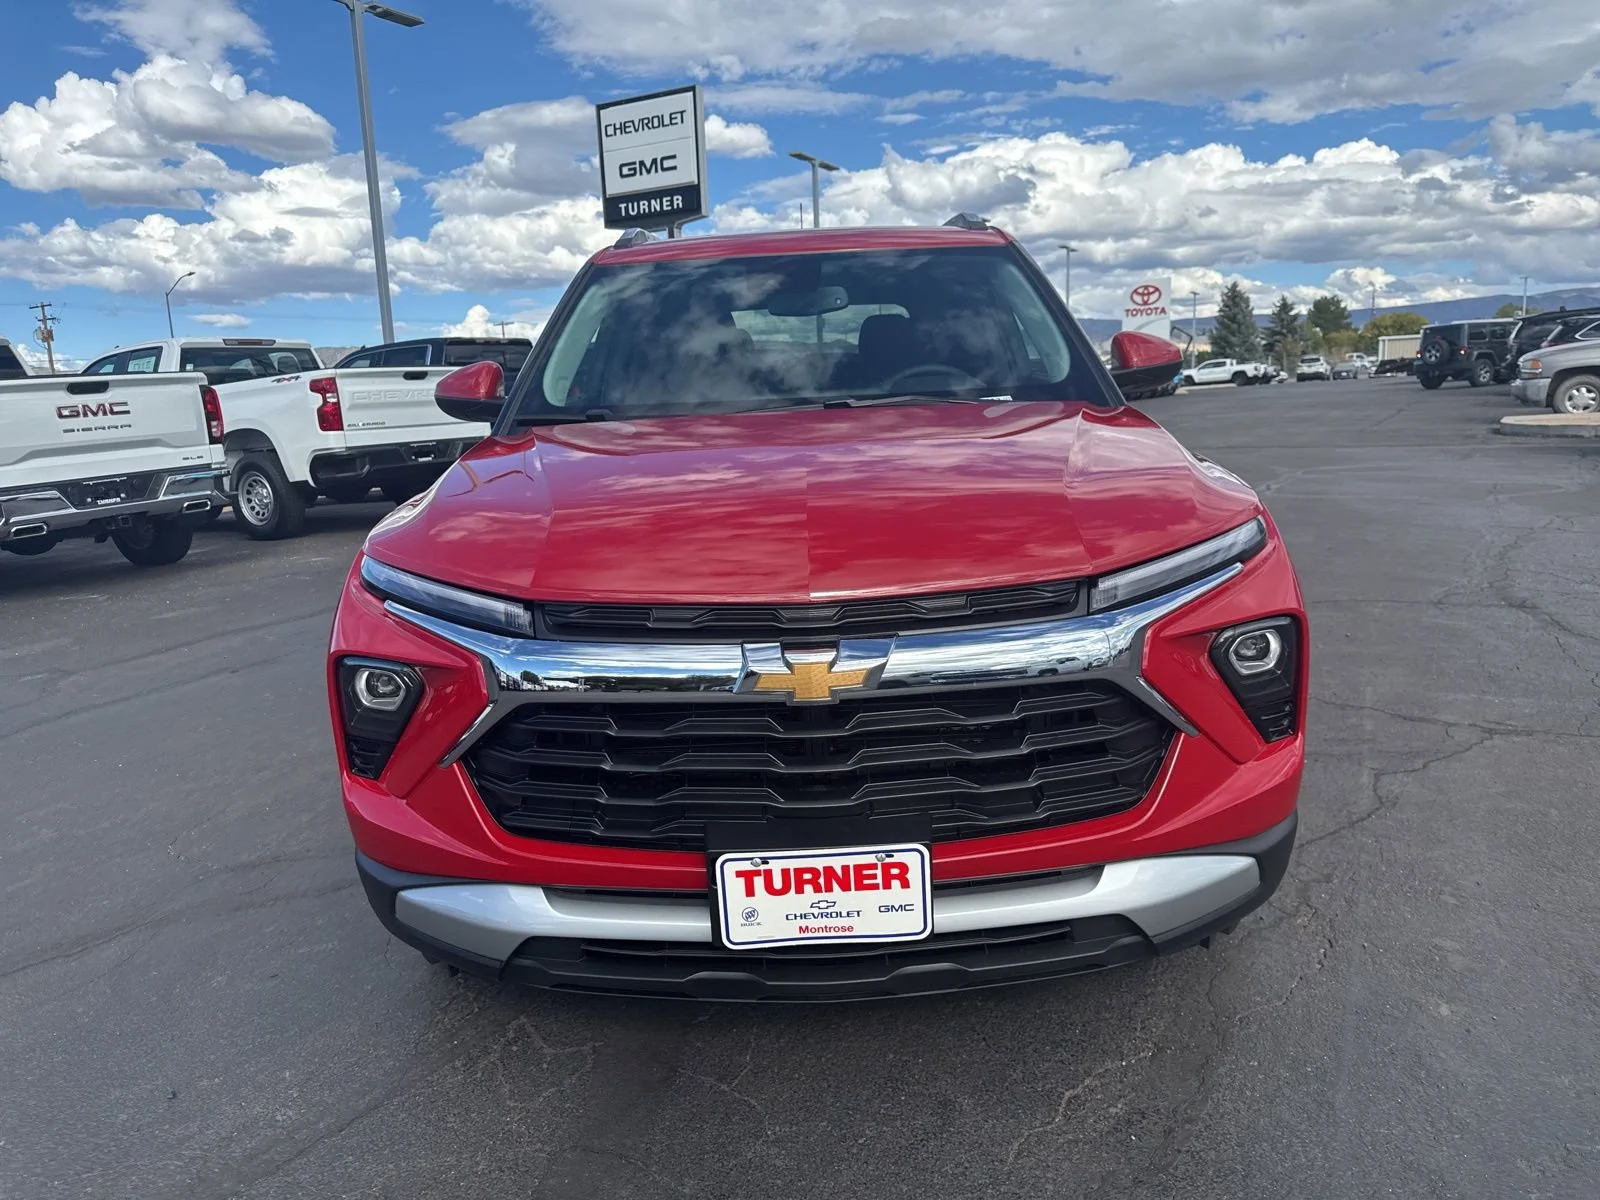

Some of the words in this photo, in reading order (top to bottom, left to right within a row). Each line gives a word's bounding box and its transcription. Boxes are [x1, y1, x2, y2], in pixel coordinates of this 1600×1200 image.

[604, 109, 687, 138] CHEVROLET
[618, 154, 678, 179] GMC
[618, 195, 683, 217] TURNER
[1124, 306, 1167, 318] TOYOTA
[56, 401, 131, 420] GMC
[62, 423, 133, 434] SIERRA
[735, 861, 911, 898] TURNER
[785, 910, 863, 921] CHEVROLET
[878, 903, 915, 913] GMC
[798, 924, 854, 935] Montrose
